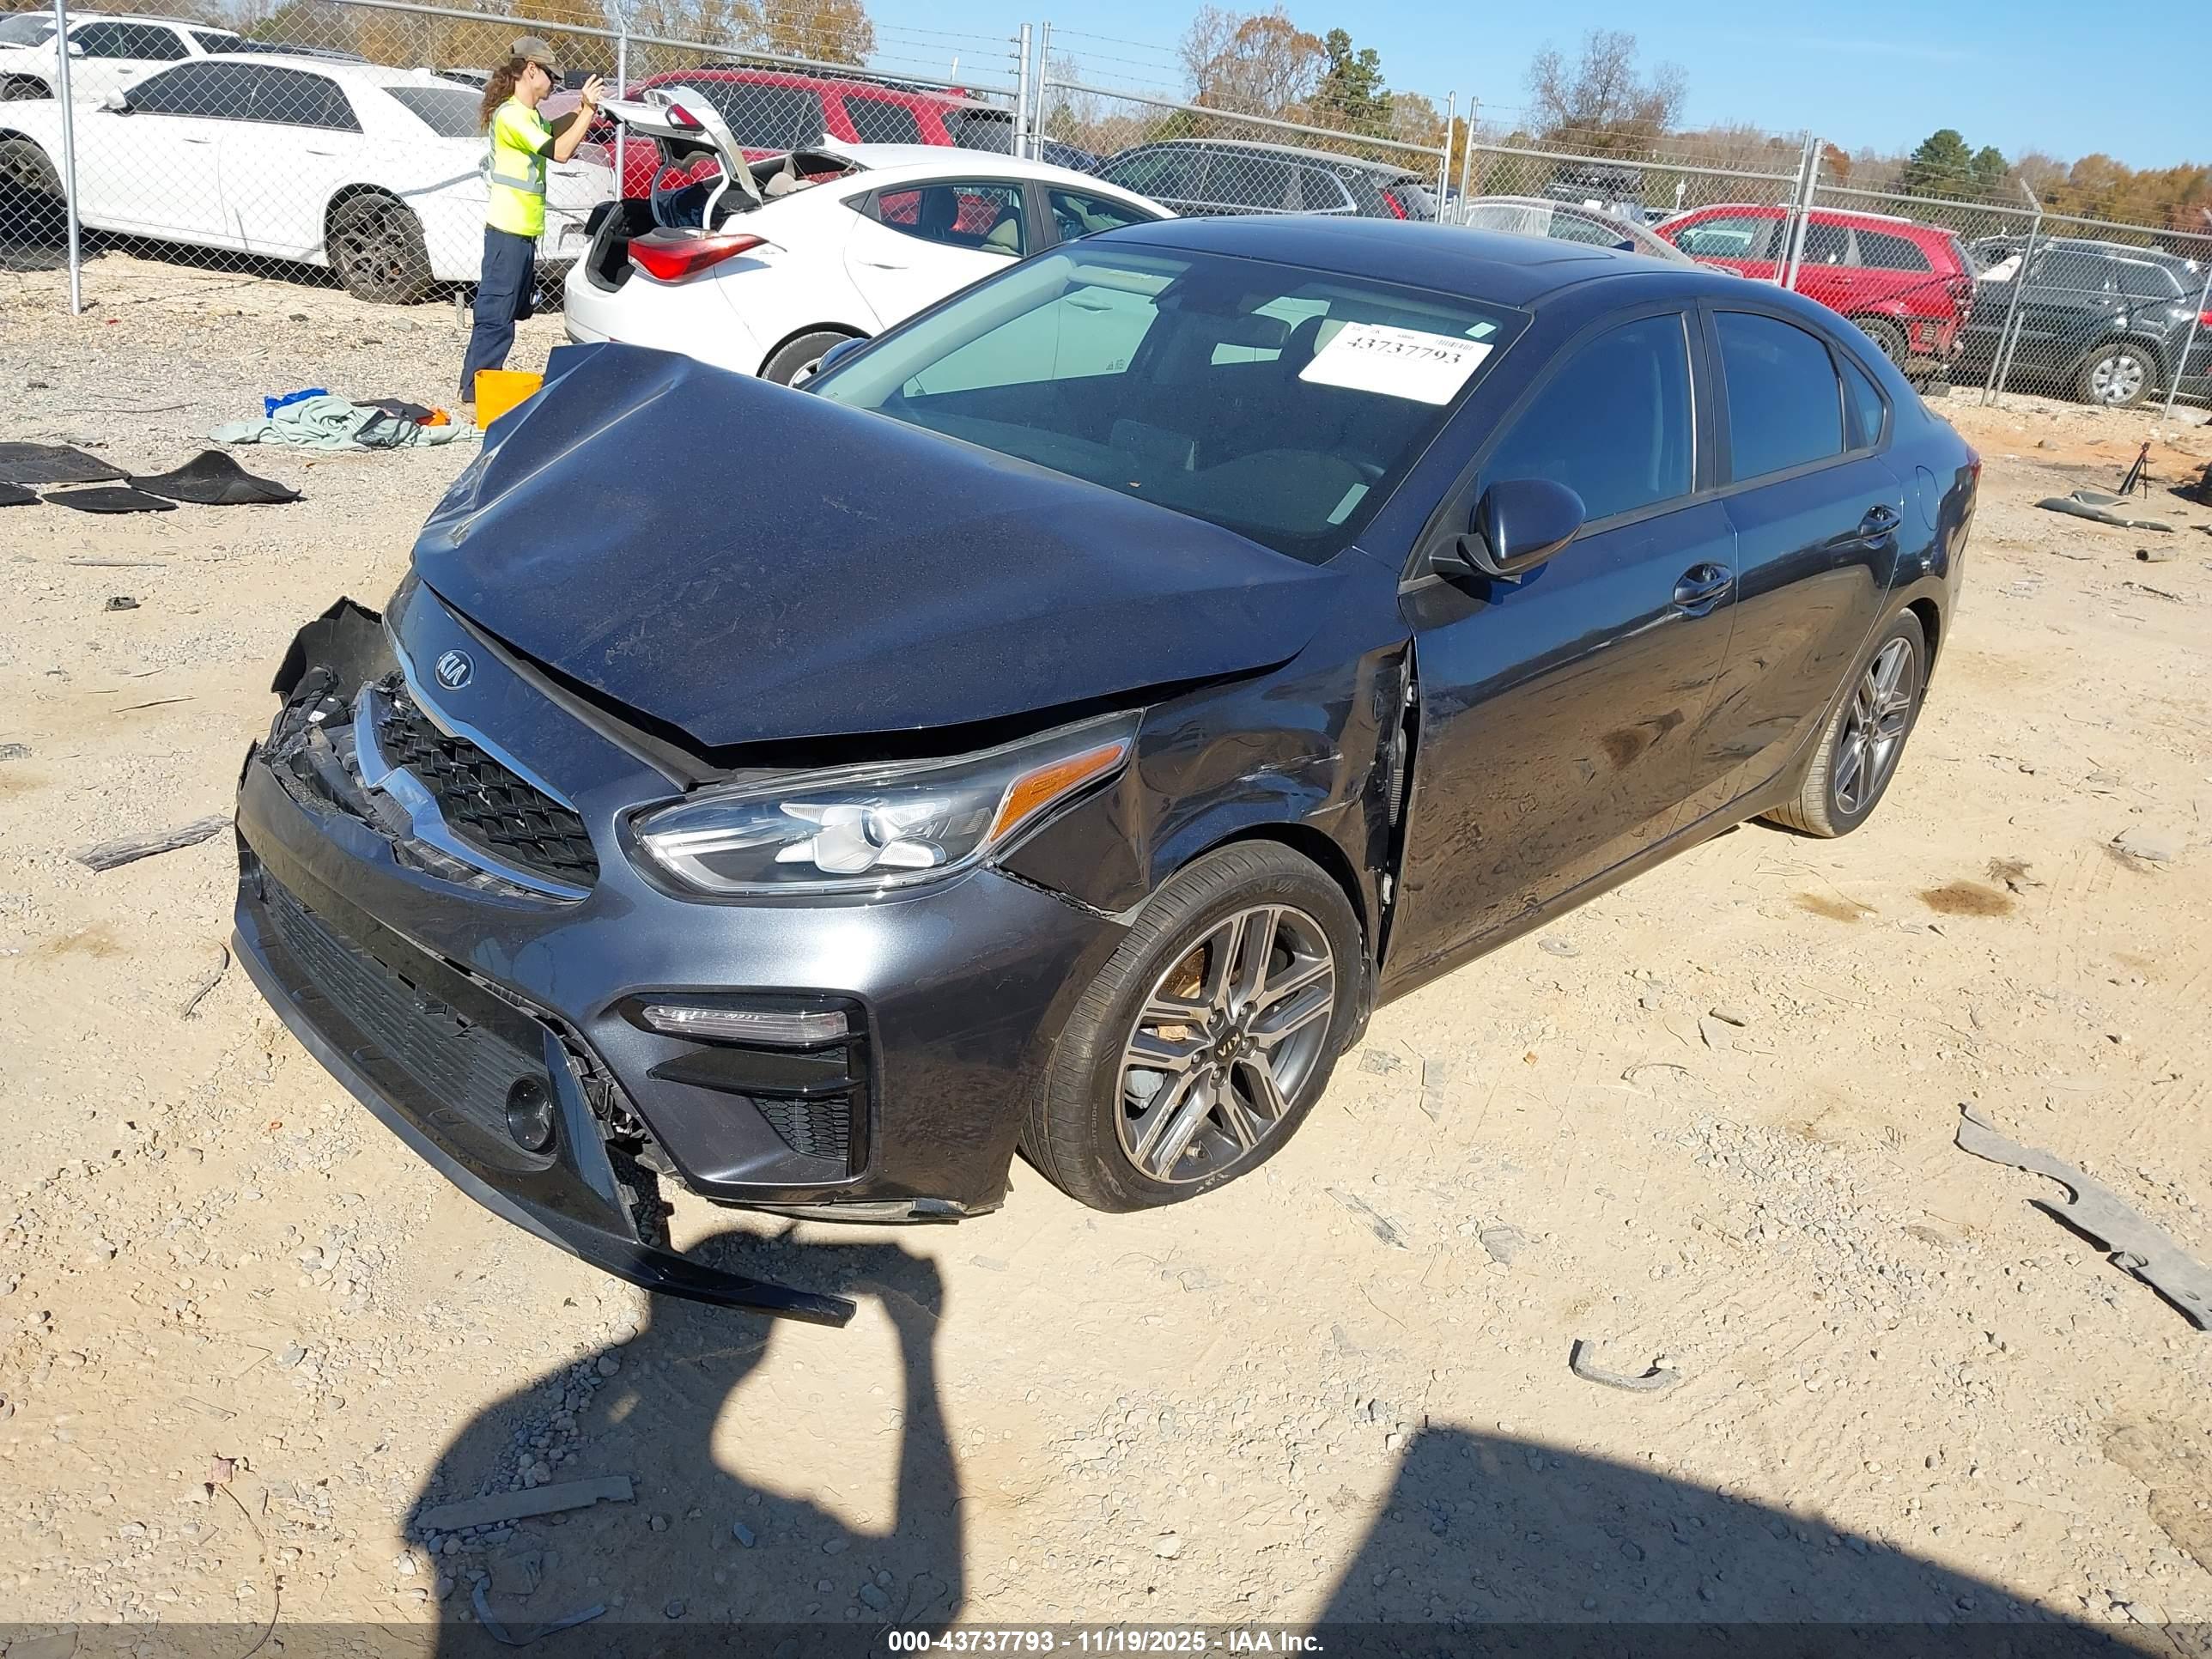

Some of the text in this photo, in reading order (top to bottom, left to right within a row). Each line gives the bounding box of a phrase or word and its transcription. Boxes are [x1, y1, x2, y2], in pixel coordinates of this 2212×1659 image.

[1346, 336, 1462, 364] 43737793
[437, 652, 467, 686] KIA
[1217, 1031, 1241, 1057] KIA
[1091, 1097, 1099, 1148] OUTSIDE
